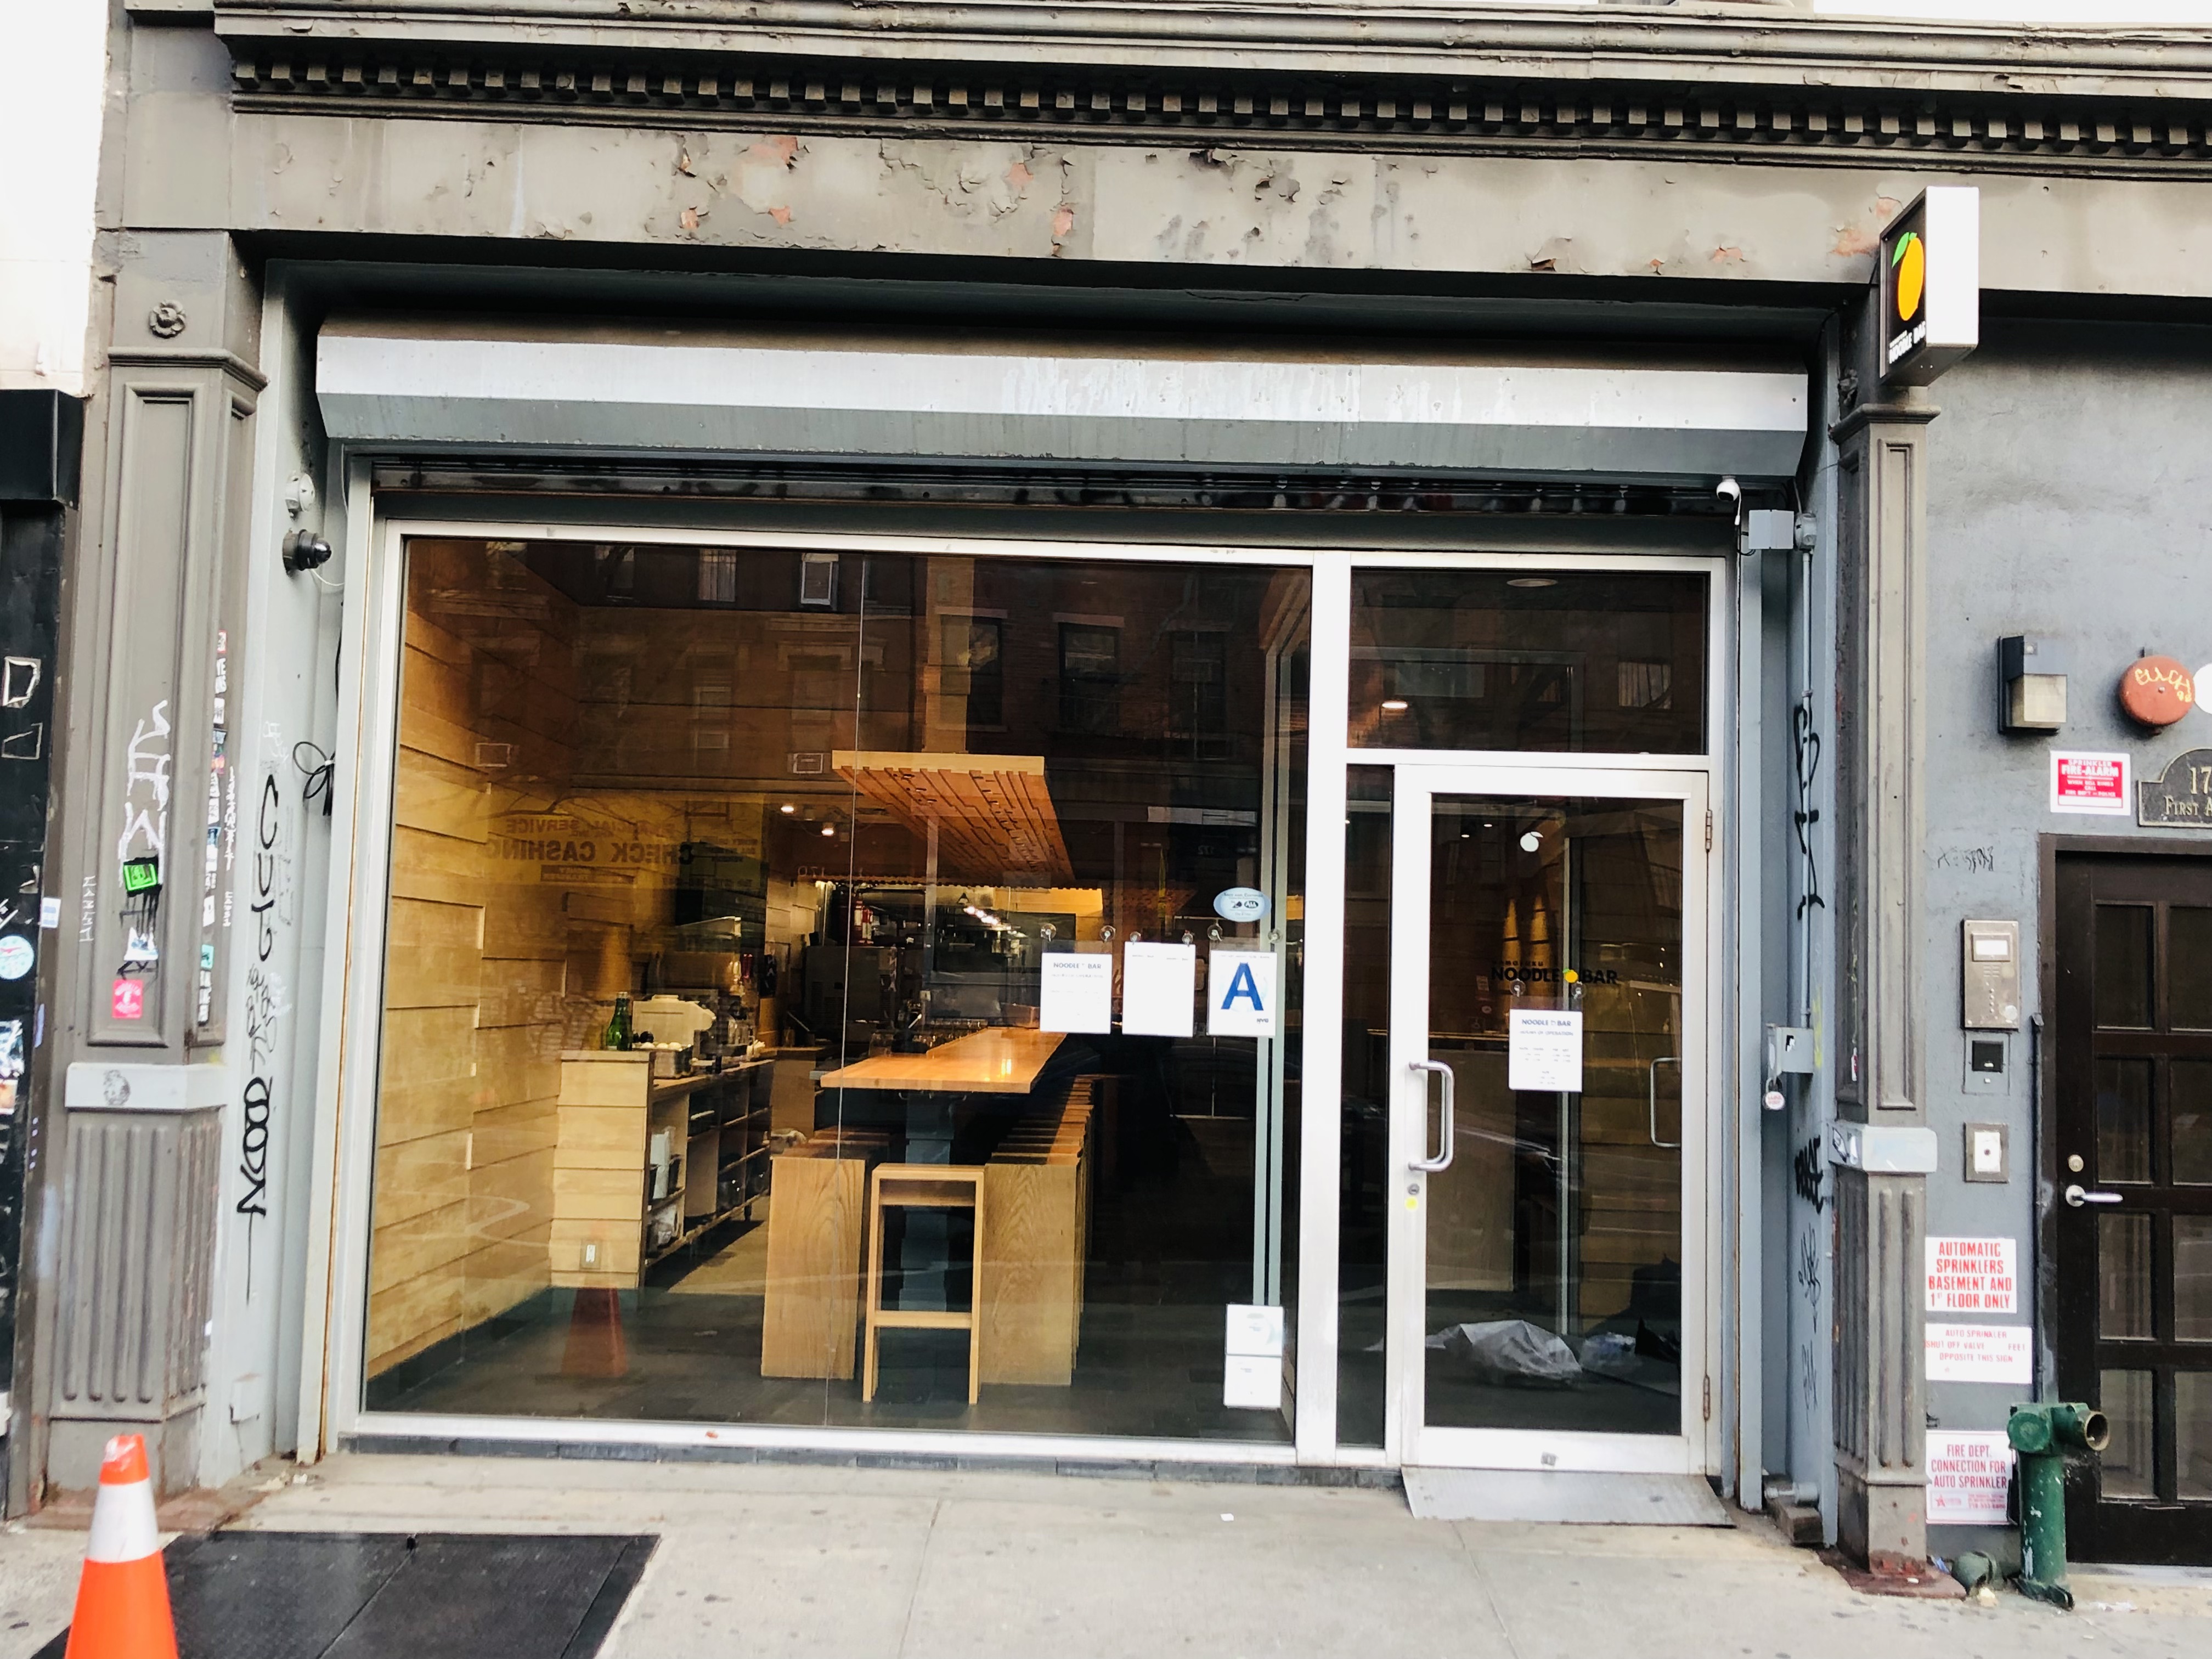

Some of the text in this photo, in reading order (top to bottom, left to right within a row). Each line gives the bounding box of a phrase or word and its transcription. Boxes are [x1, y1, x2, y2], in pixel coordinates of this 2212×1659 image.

[2061, 764, 2119, 777] FIRE-ALARM
[1491, 966, 1617, 984] NOODLE BAR
[1221, 962, 1264, 1011] A
[1939, 1242, 2001, 1257] AUTOMATIC
[1936, 1259, 2004, 1274] SPRINKLERS
[1928, 1276, 2012, 1291] BASEMENT AND
[1947, 1293, 1980, 1308] FLOOR
[1984, 1294, 2010, 1309] ONLY
[1967, 1330, 2007, 1339] SPRINKLER
[1948, 1341, 1960, 1349] OFF
[2008, 1343, 2025, 1351] FEET
[1939, 1352, 2013, 1363] OPPOSITE THIS SIGN
[1947, 1444, 1966, 1458] FIRE
[1931, 1459, 2007, 1474] CONNECTION FOR
[1934, 1475, 2007, 1489] AUTO SPRINKLER
